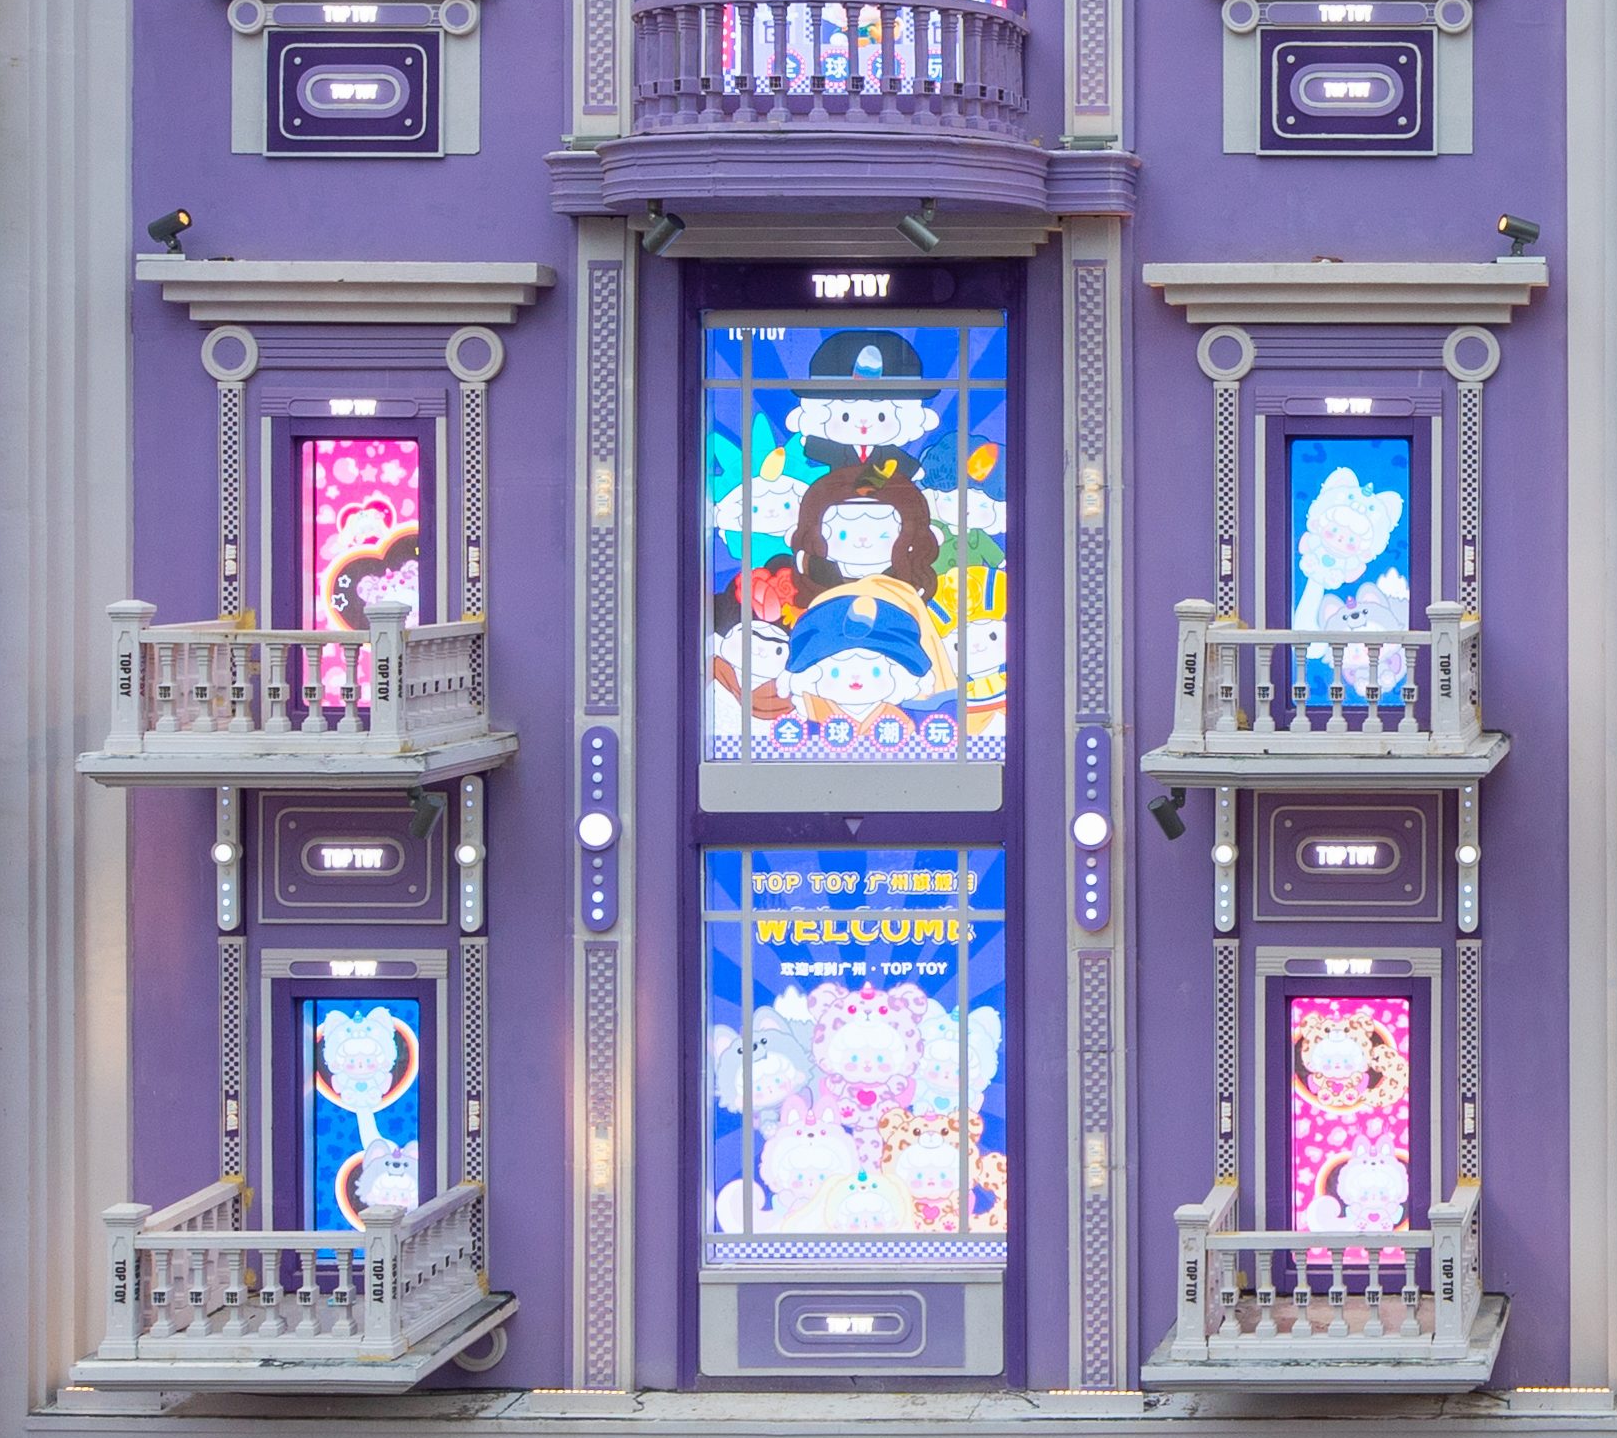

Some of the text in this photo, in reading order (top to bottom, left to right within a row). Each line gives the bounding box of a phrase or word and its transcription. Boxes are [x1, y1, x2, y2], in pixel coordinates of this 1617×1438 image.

[812, 274, 890, 298] TOP TOY
[120, 652, 131, 697] TOP TOY
[1440, 654, 1451, 698] TOP TOY
[778, 722, 949, 744] 全球潮玩
[753, 872, 801, 894] TOP
[808, 872, 859, 894] TOY
[881, 963, 912, 975] TOP
[917, 963, 948, 975] TOY
